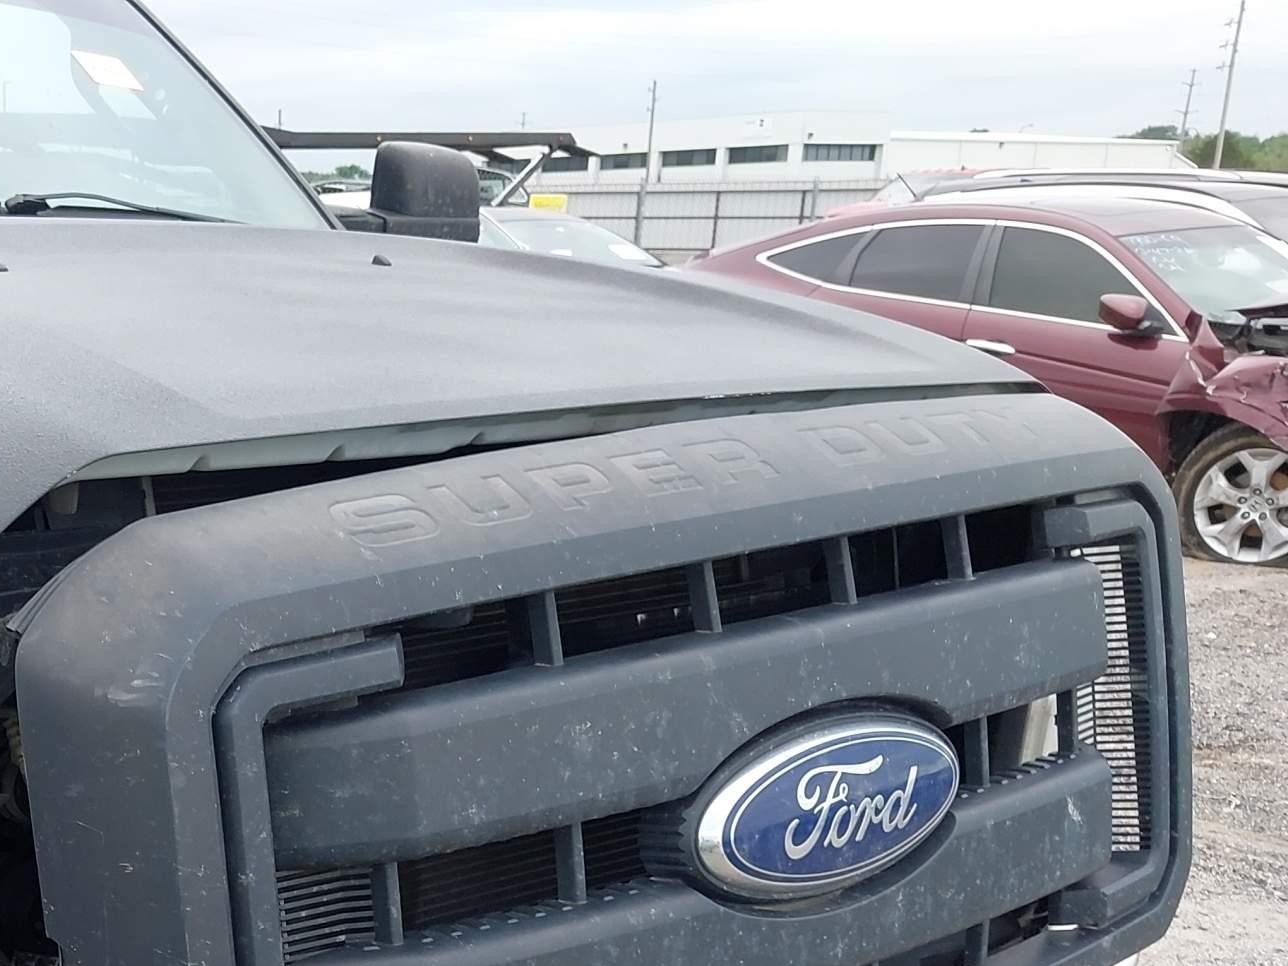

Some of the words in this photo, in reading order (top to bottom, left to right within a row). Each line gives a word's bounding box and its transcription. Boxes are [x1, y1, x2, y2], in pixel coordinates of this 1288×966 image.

[328, 438, 781, 548] SUPER
[797, 406, 1042, 468] DUTY
[784, 755, 918, 860] Ford
